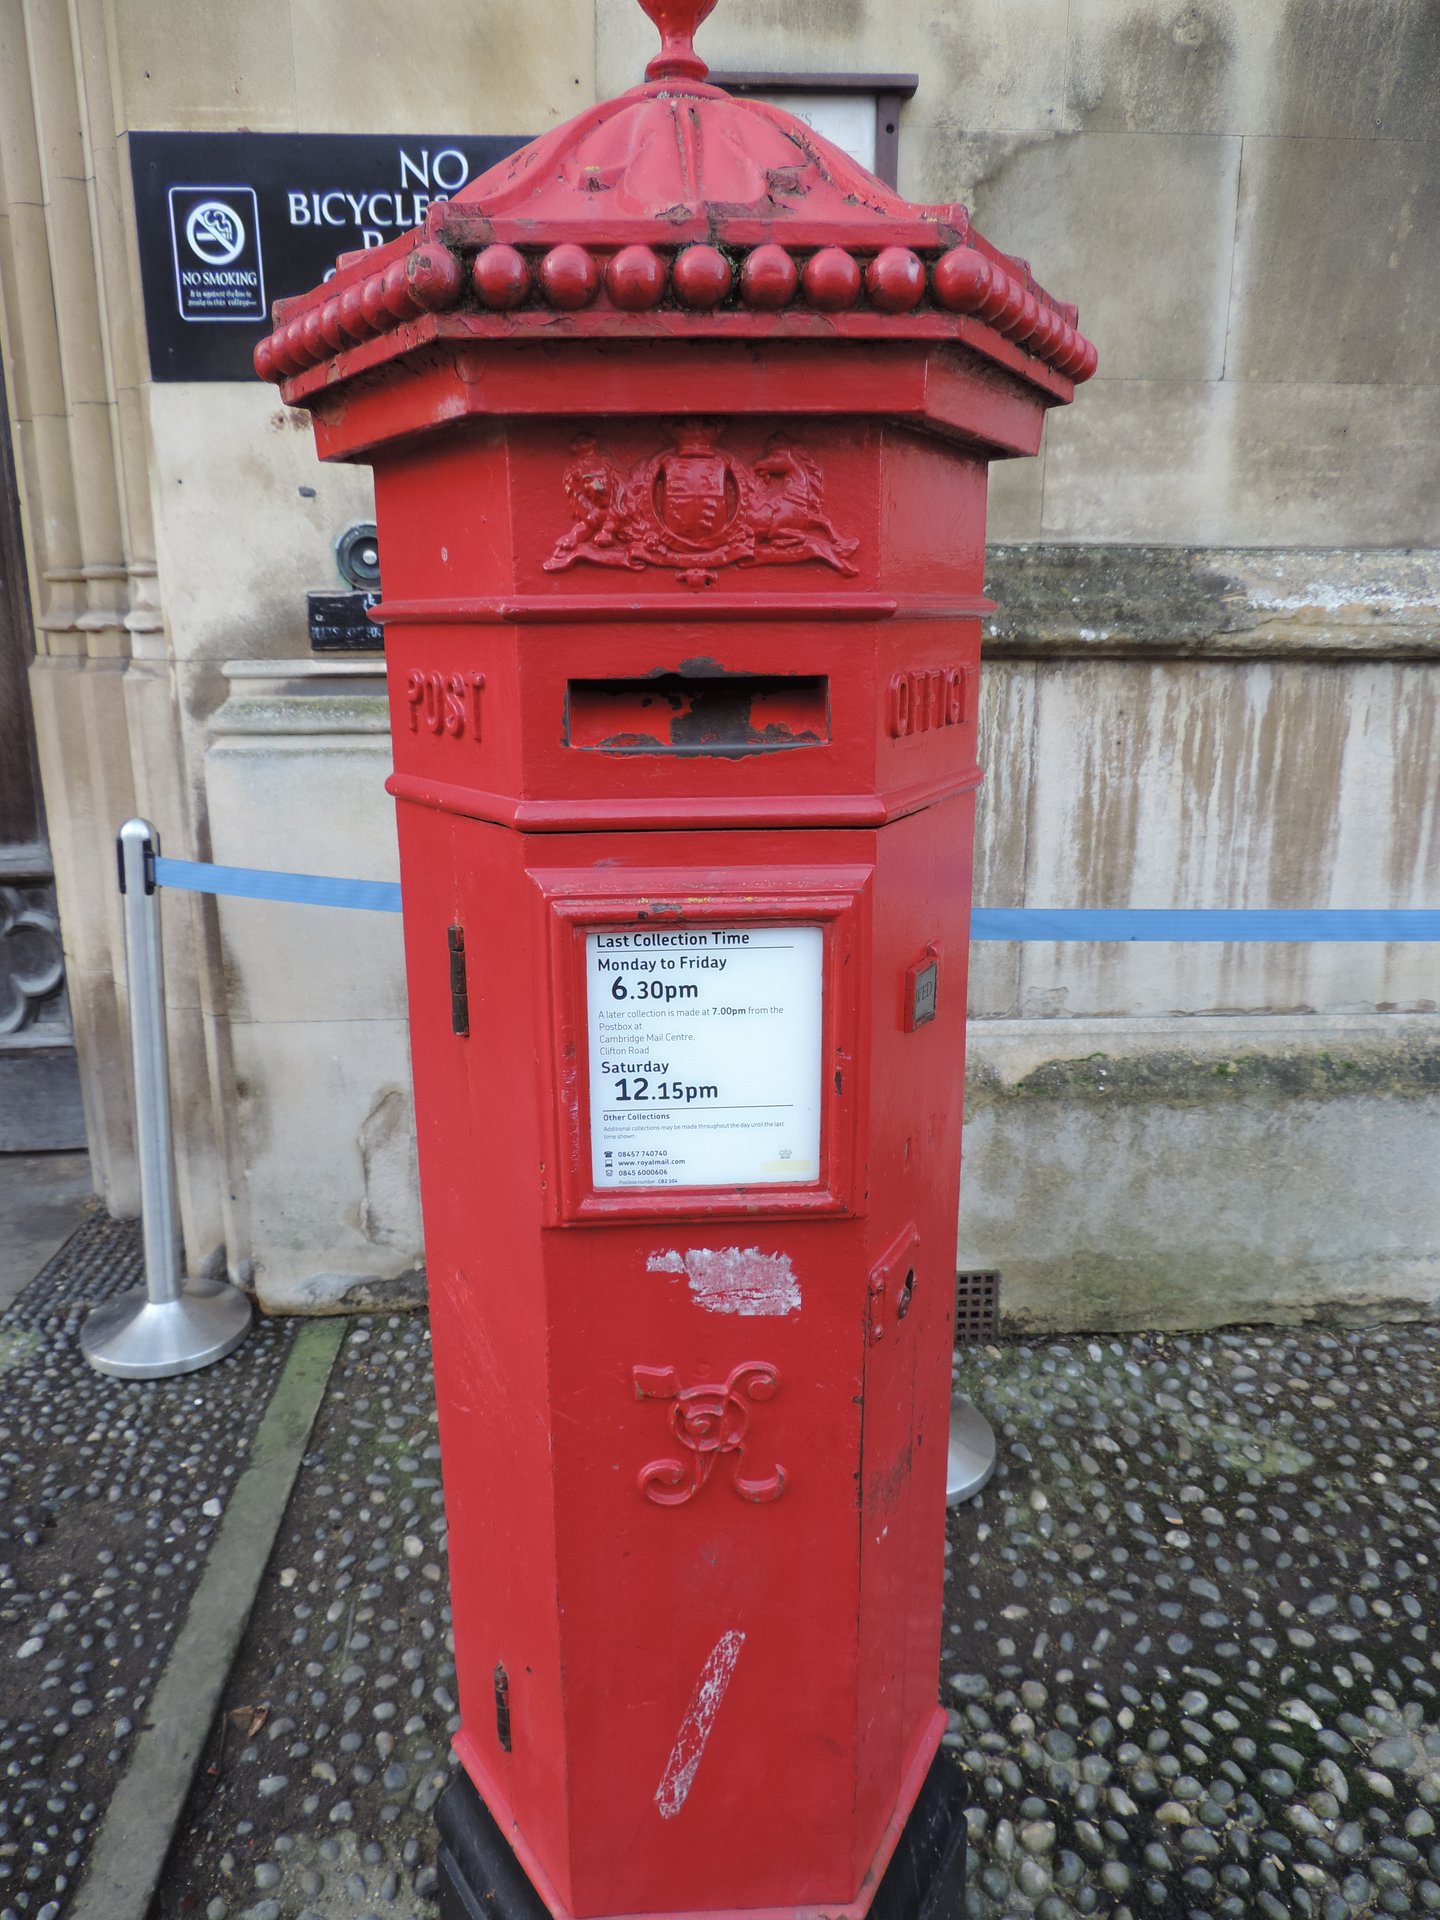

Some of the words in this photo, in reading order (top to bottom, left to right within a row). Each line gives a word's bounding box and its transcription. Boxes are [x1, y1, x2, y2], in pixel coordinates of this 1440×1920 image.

[400, 150, 469, 190] NO
[288, 193, 449, 226] BICYCLE
[182, 272, 202, 286] NO
[202, 272, 258, 286] SMOKING
[406, 668, 486, 743] POST
[889, 664, 975, 739] OFFICE
[596, 934, 630, 948] Last
[632, 932, 708, 947] Collection
[712, 932, 750, 945] Time
[598, 958, 657, 973] Monday
[660, 958, 676, 970] to
[680, 956, 727, 972] Friday
[612, 976, 698, 1003] 6.30pm
[916, 981, 933, 1003] WED
[598, 1010, 604, 1018] A
[606, 1010, 625, 1018] later
[628, 1009, 666, 1018] collection
[668, 1008, 674, 1017] is
[676, 1008, 700, 1016] made
[712, 1006, 746, 1016] 7.00pm
[748, 1006, 768, 1015] from
[770, 1006, 784, 1014] the
[599, 1022, 632, 1032] Postbox
[600, 1034, 645, 1044] Cambridge
[646, 1034, 664, 1042] Mail
[665, 1032, 696, 1042] Centre,
[600, 1046, 627, 1056] Clifton
[628, 1046, 650, 1055] Road
[601, 1061, 670, 1076] Saturday
[615, 1077, 718, 1103] 12.15pm
[603, 1114, 626, 1122] Other
[627, 1112, 671, 1121] Collections
[698, 1122, 730, 1130] throughout
[618, 1158, 686, 1167] www.royalmail.com
